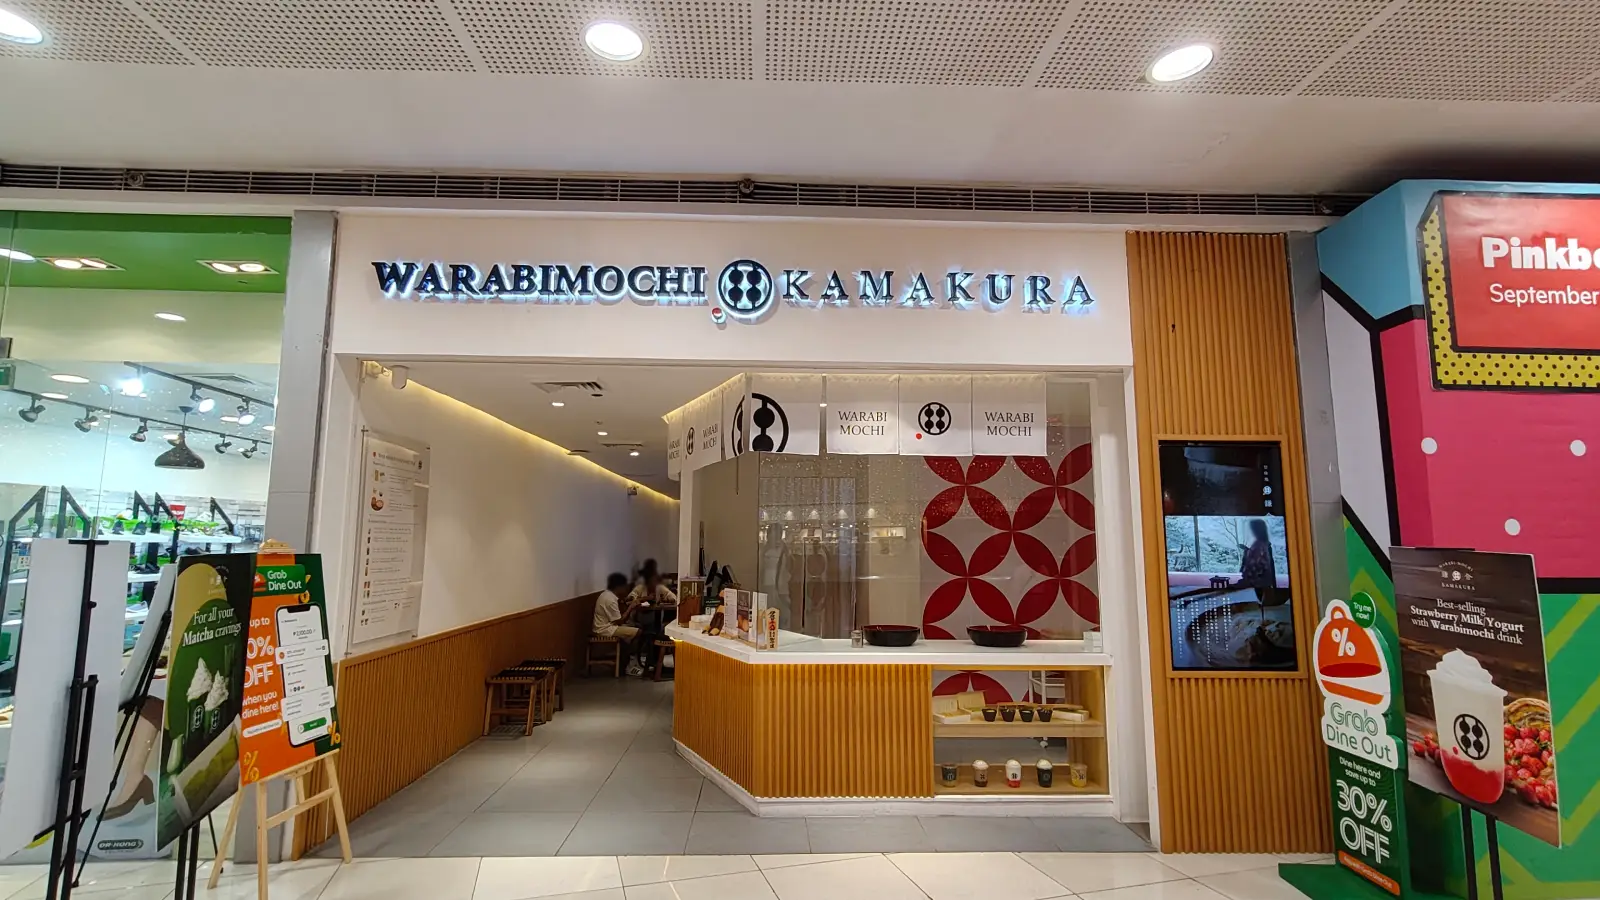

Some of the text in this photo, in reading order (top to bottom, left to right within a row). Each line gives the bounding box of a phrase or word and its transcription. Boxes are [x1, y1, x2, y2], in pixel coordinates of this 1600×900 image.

[371, 261, 707, 298] WARABIMOCHI
[783, 269, 1095, 305] KAMAKURA
[1489, 283, 1599, 308] September
[838, 411, 887, 422] WARABI
[985, 411, 1034, 423] WARABI
[840, 425, 884, 436] MOCHI
[986, 425, 1032, 437] MOCHI
[267, 570, 287, 580] Grab
[268, 580, 302, 591] Dine Out
[193, 606, 235, 626] For all your
[1353, 602, 1363, 612] Try
[1436, 599, 1486, 616] Best-selling
[249, 619, 260, 628] up
[262, 617, 270, 625] to
[1410, 605, 1524, 633] Strawberry Milk/Yogurt
[182, 622, 242, 647] Matcha cravings
[1411, 617, 1523, 645] with Warabimochi drink
[242, 690, 278, 706] when you
[242, 707, 259, 719] dine
[259, 702, 280, 714] here!
[1330, 702, 1379, 737] Grab
[1326, 724, 1392, 763] Dine Out
[1339, 756, 1381, 780] Dine here and
[1345, 768, 1377, 787] save up to
[1336, 779, 1393, 832] 30%
[1339, 816, 1390, 864] OFF
